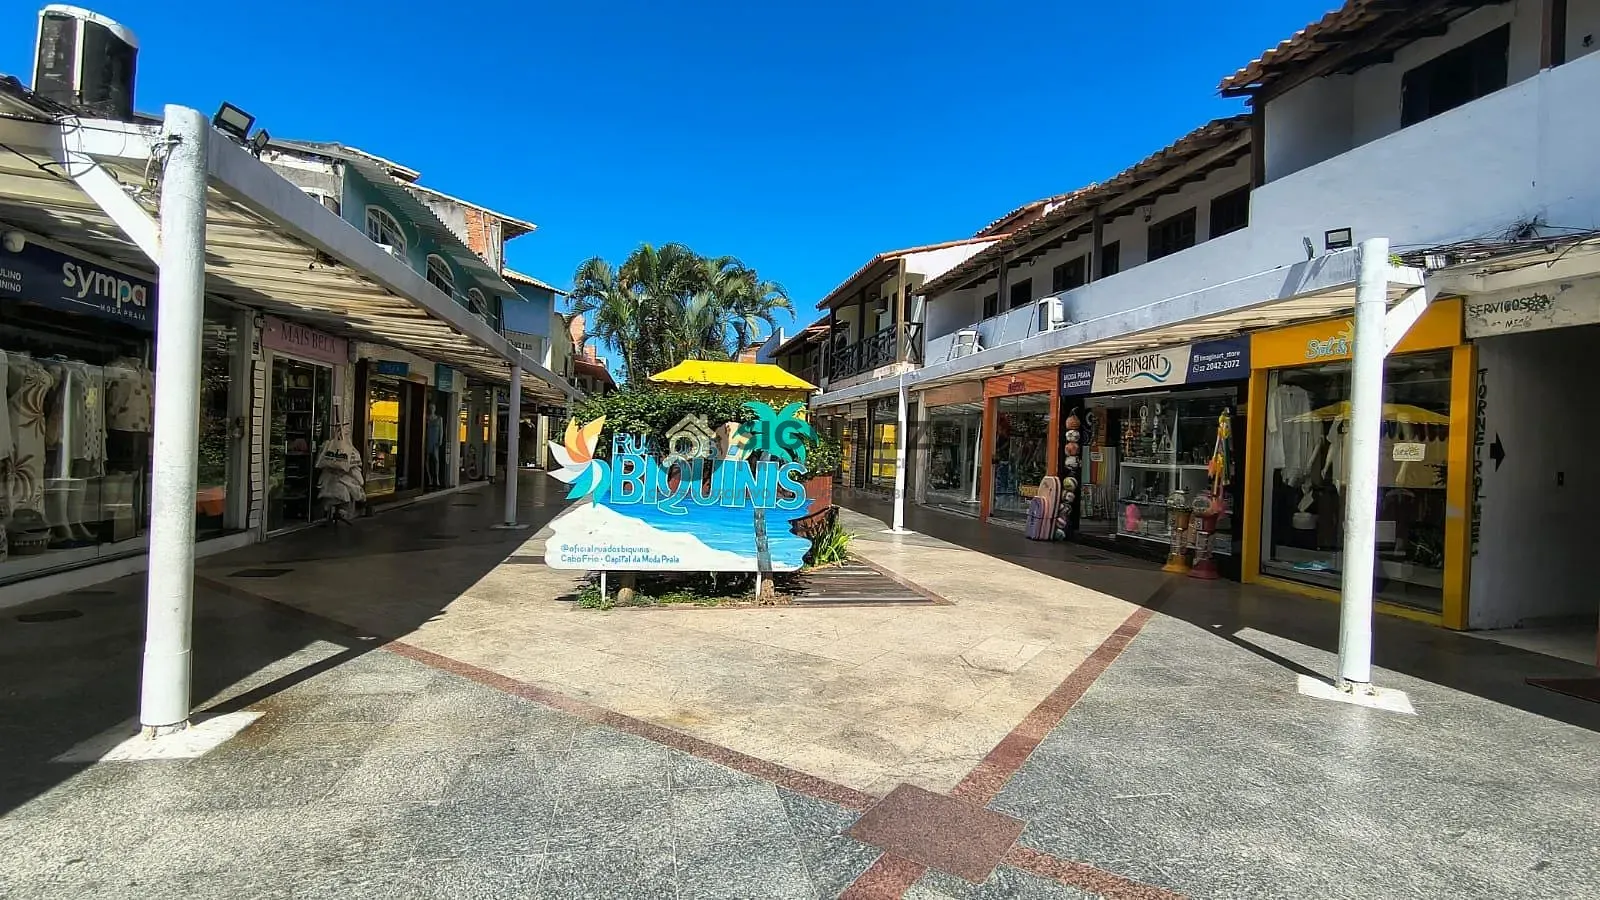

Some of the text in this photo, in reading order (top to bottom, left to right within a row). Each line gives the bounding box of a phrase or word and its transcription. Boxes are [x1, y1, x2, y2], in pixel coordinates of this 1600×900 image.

[62, 261, 147, 308] sympa
[281, 323, 310, 346] MAIS
[1206, 359, 1240, 371] 2042-2072
[1106, 376, 1128, 385] STORE
[609, 454, 808, 516] BIQUINIS
